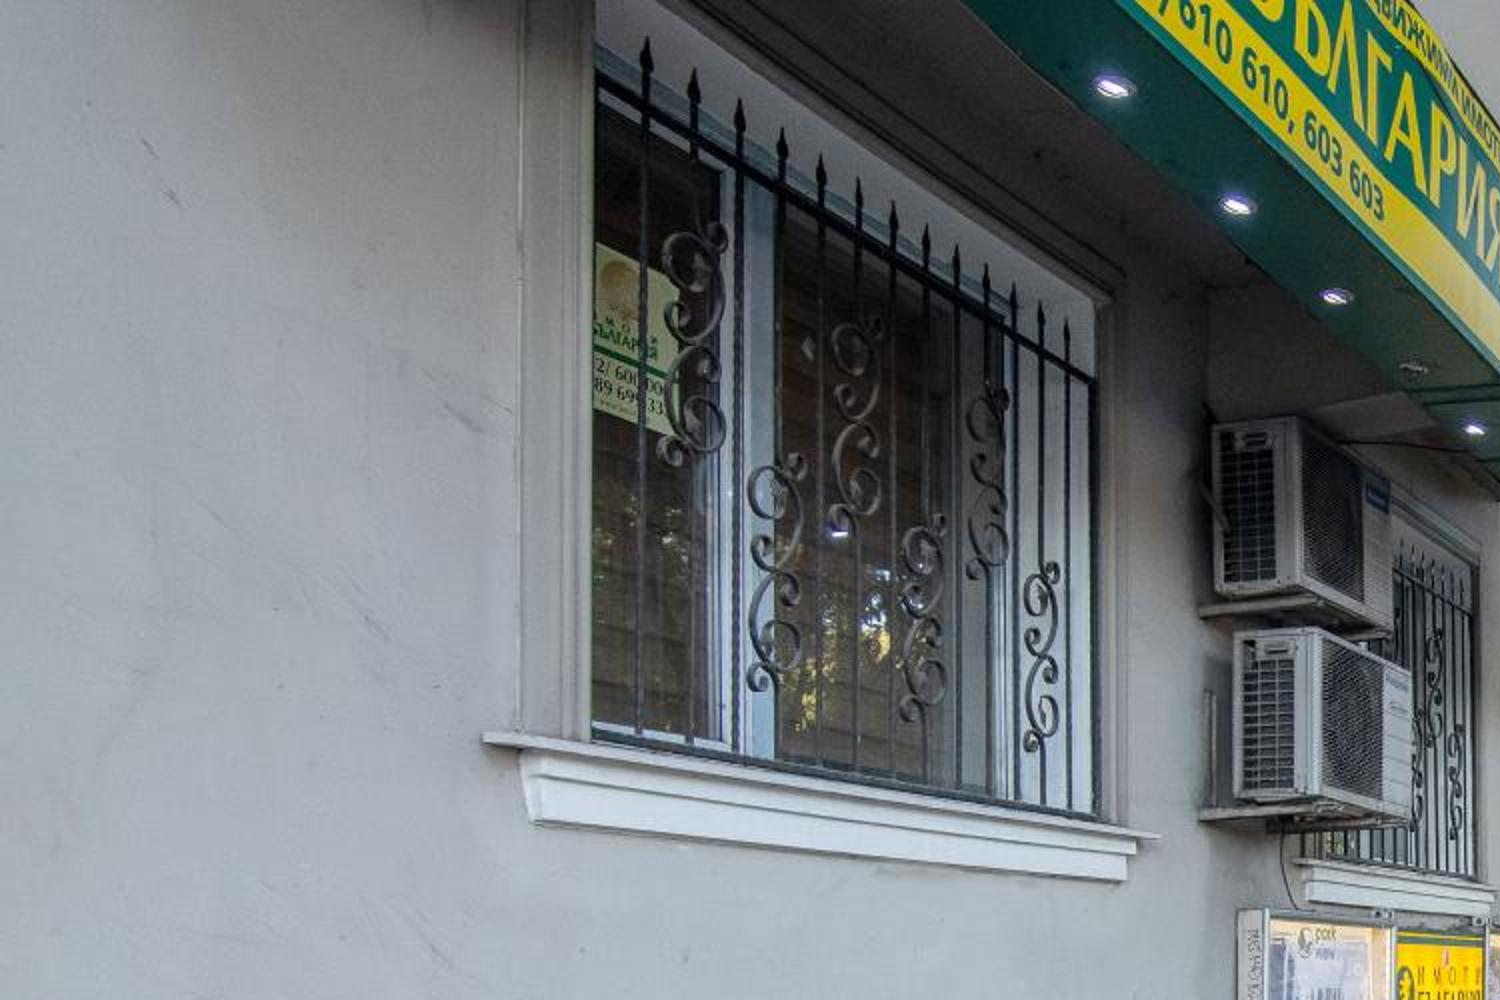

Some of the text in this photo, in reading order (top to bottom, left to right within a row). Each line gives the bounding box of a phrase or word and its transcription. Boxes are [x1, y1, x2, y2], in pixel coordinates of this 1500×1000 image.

[1241, 46, 1295, 135] 610,
[1303, 110, 1343, 177] 603
[1349, 159, 1385, 222] 603
[1417, 965, 1481, 986] ИМОТИ
